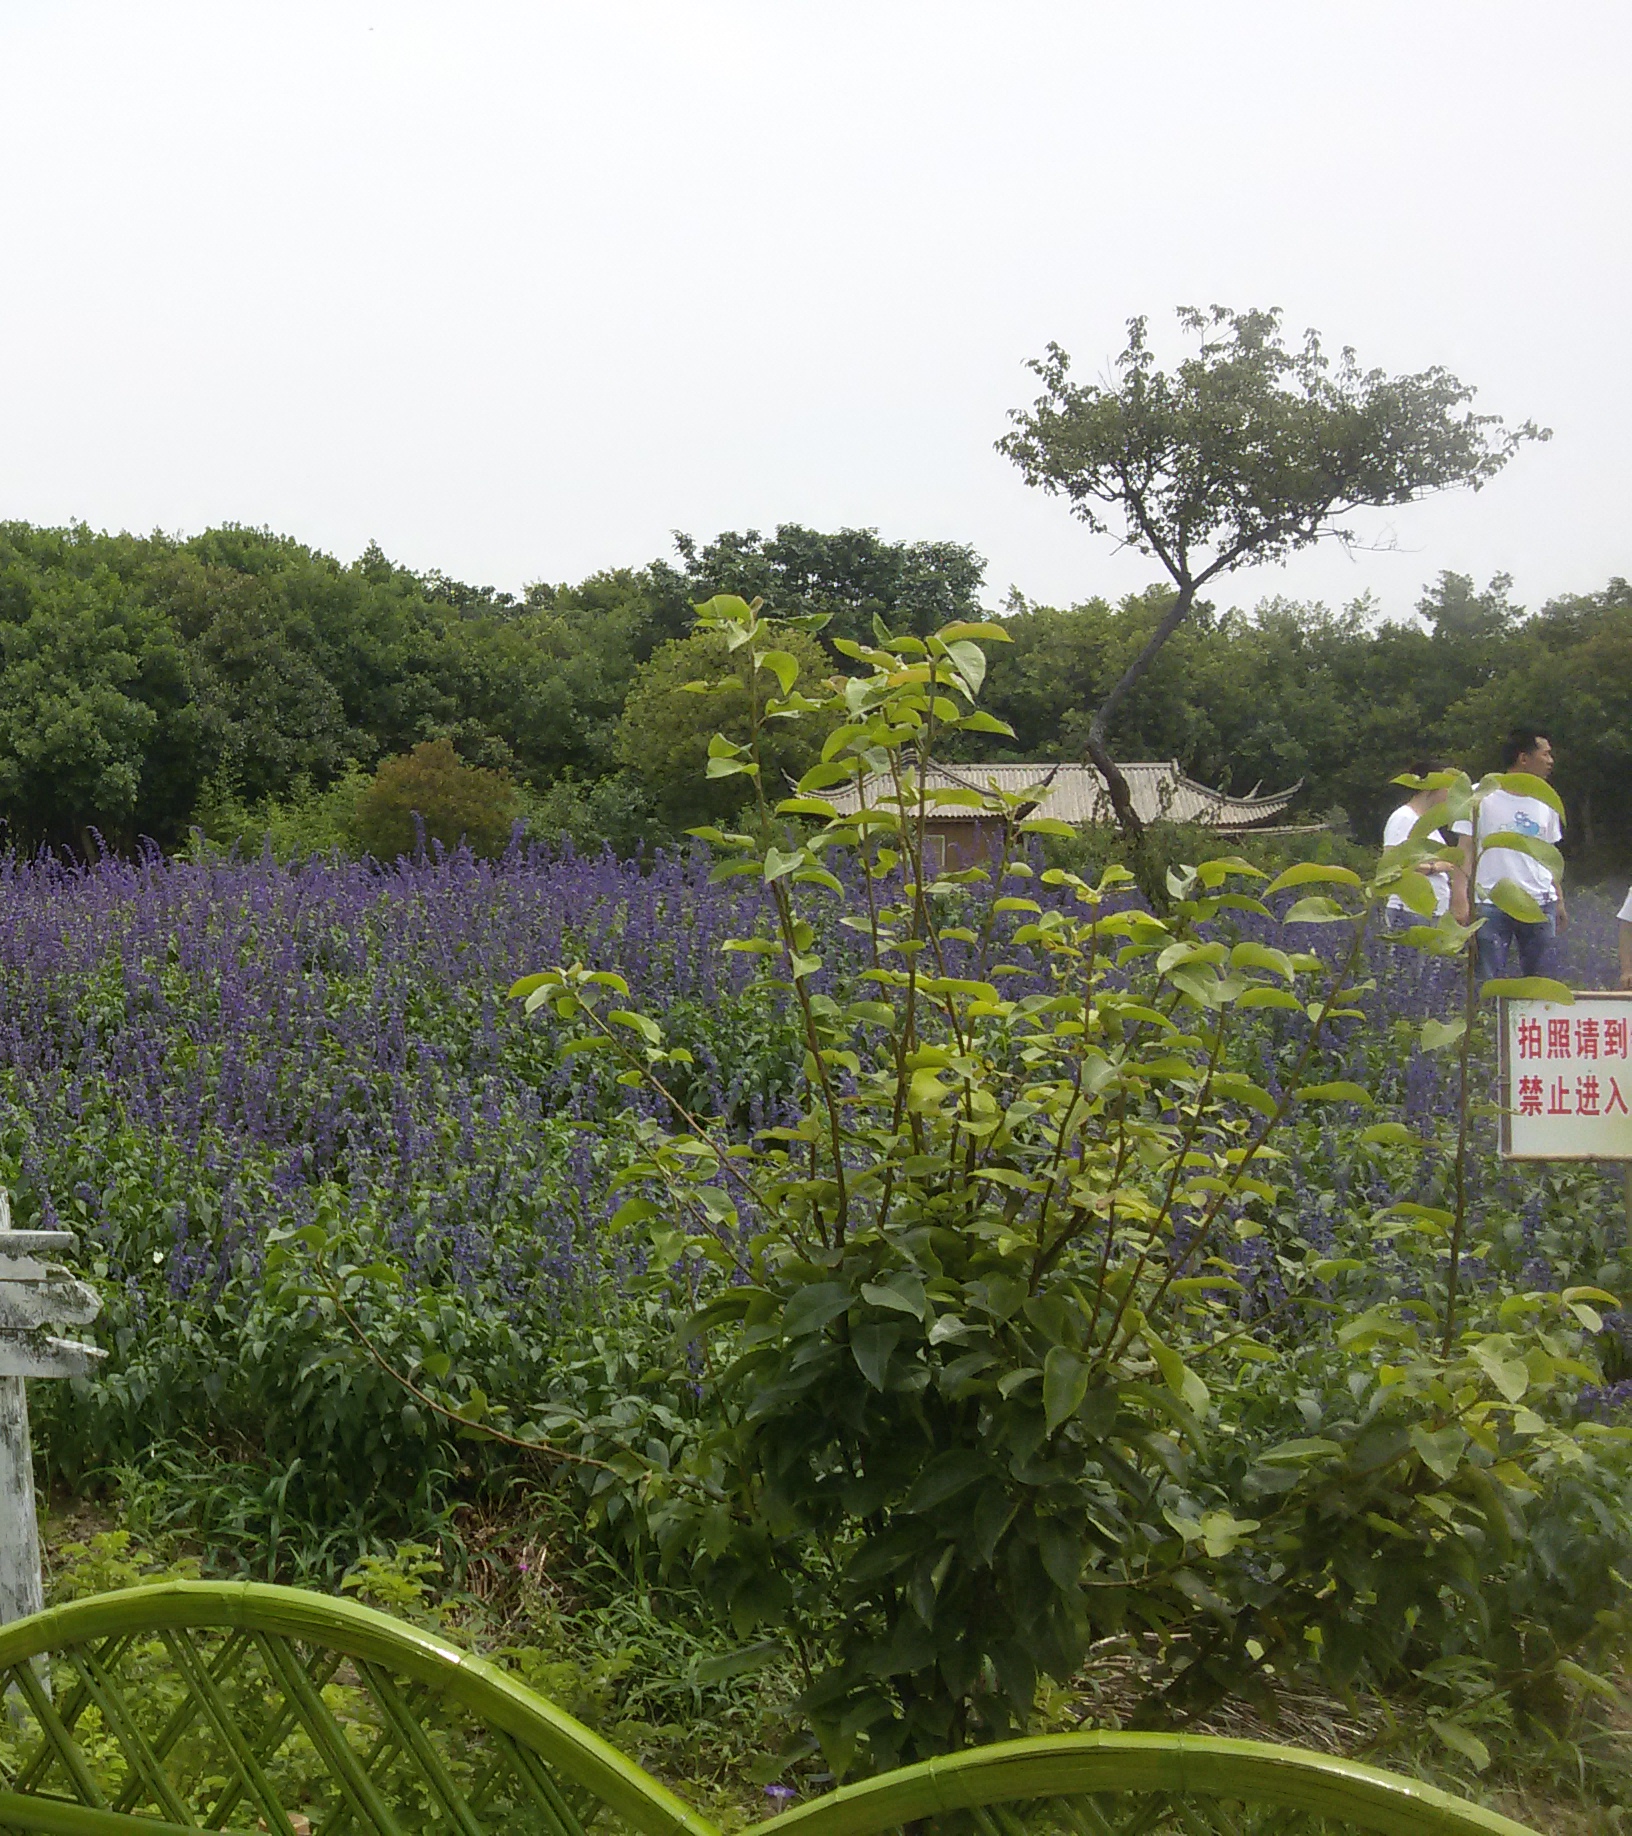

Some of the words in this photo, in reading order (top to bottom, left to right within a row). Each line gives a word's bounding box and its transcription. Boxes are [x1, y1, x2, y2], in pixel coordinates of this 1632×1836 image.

[1518, 1018, 1632, 1059] 拍照请到
[1518, 1075, 1629, 1116] 禁止进入
